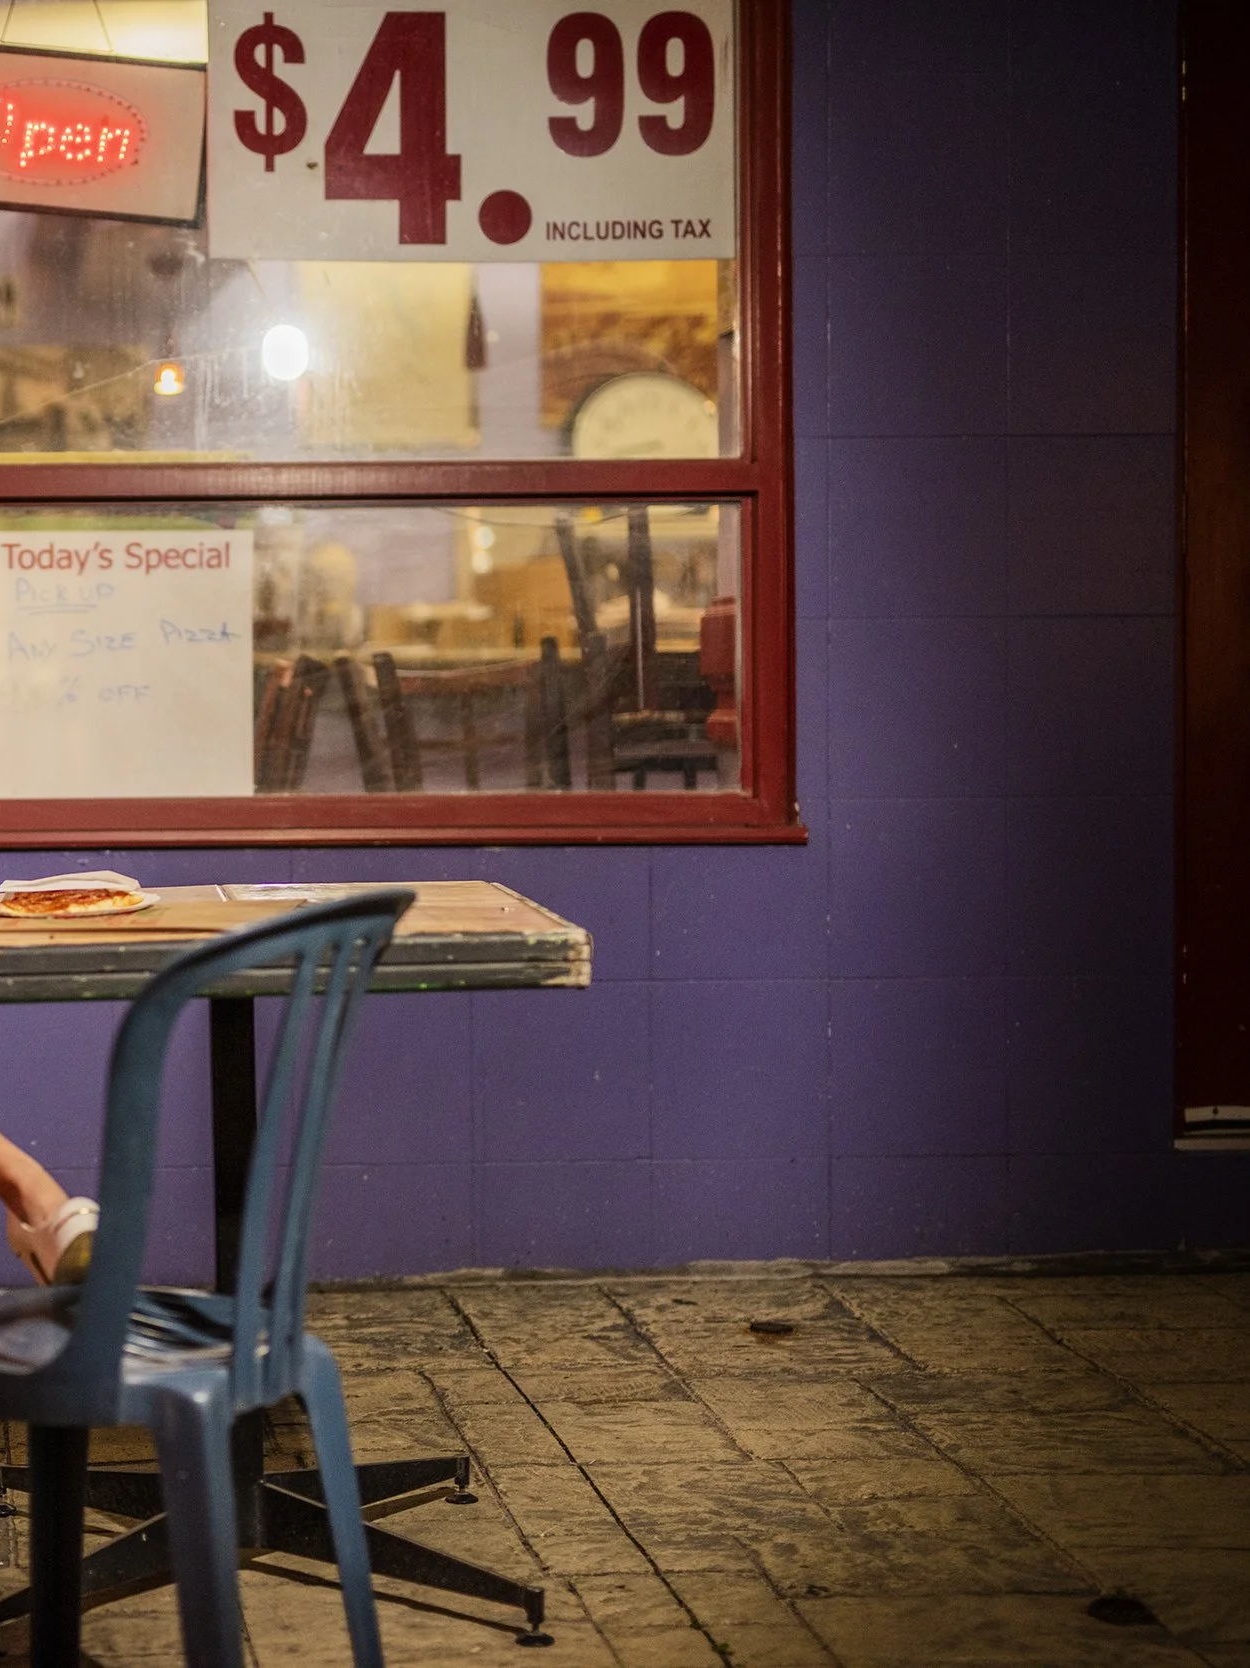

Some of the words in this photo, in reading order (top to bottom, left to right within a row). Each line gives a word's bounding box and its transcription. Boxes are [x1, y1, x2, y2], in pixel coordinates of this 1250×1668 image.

[233, 11, 715, 246] $4.99
[545, 219, 664, 241] INCLUDING
[671, 218, 712, 240] TAX
[1, 541, 113, 575] Today's
[124, 541, 232, 575] Special
